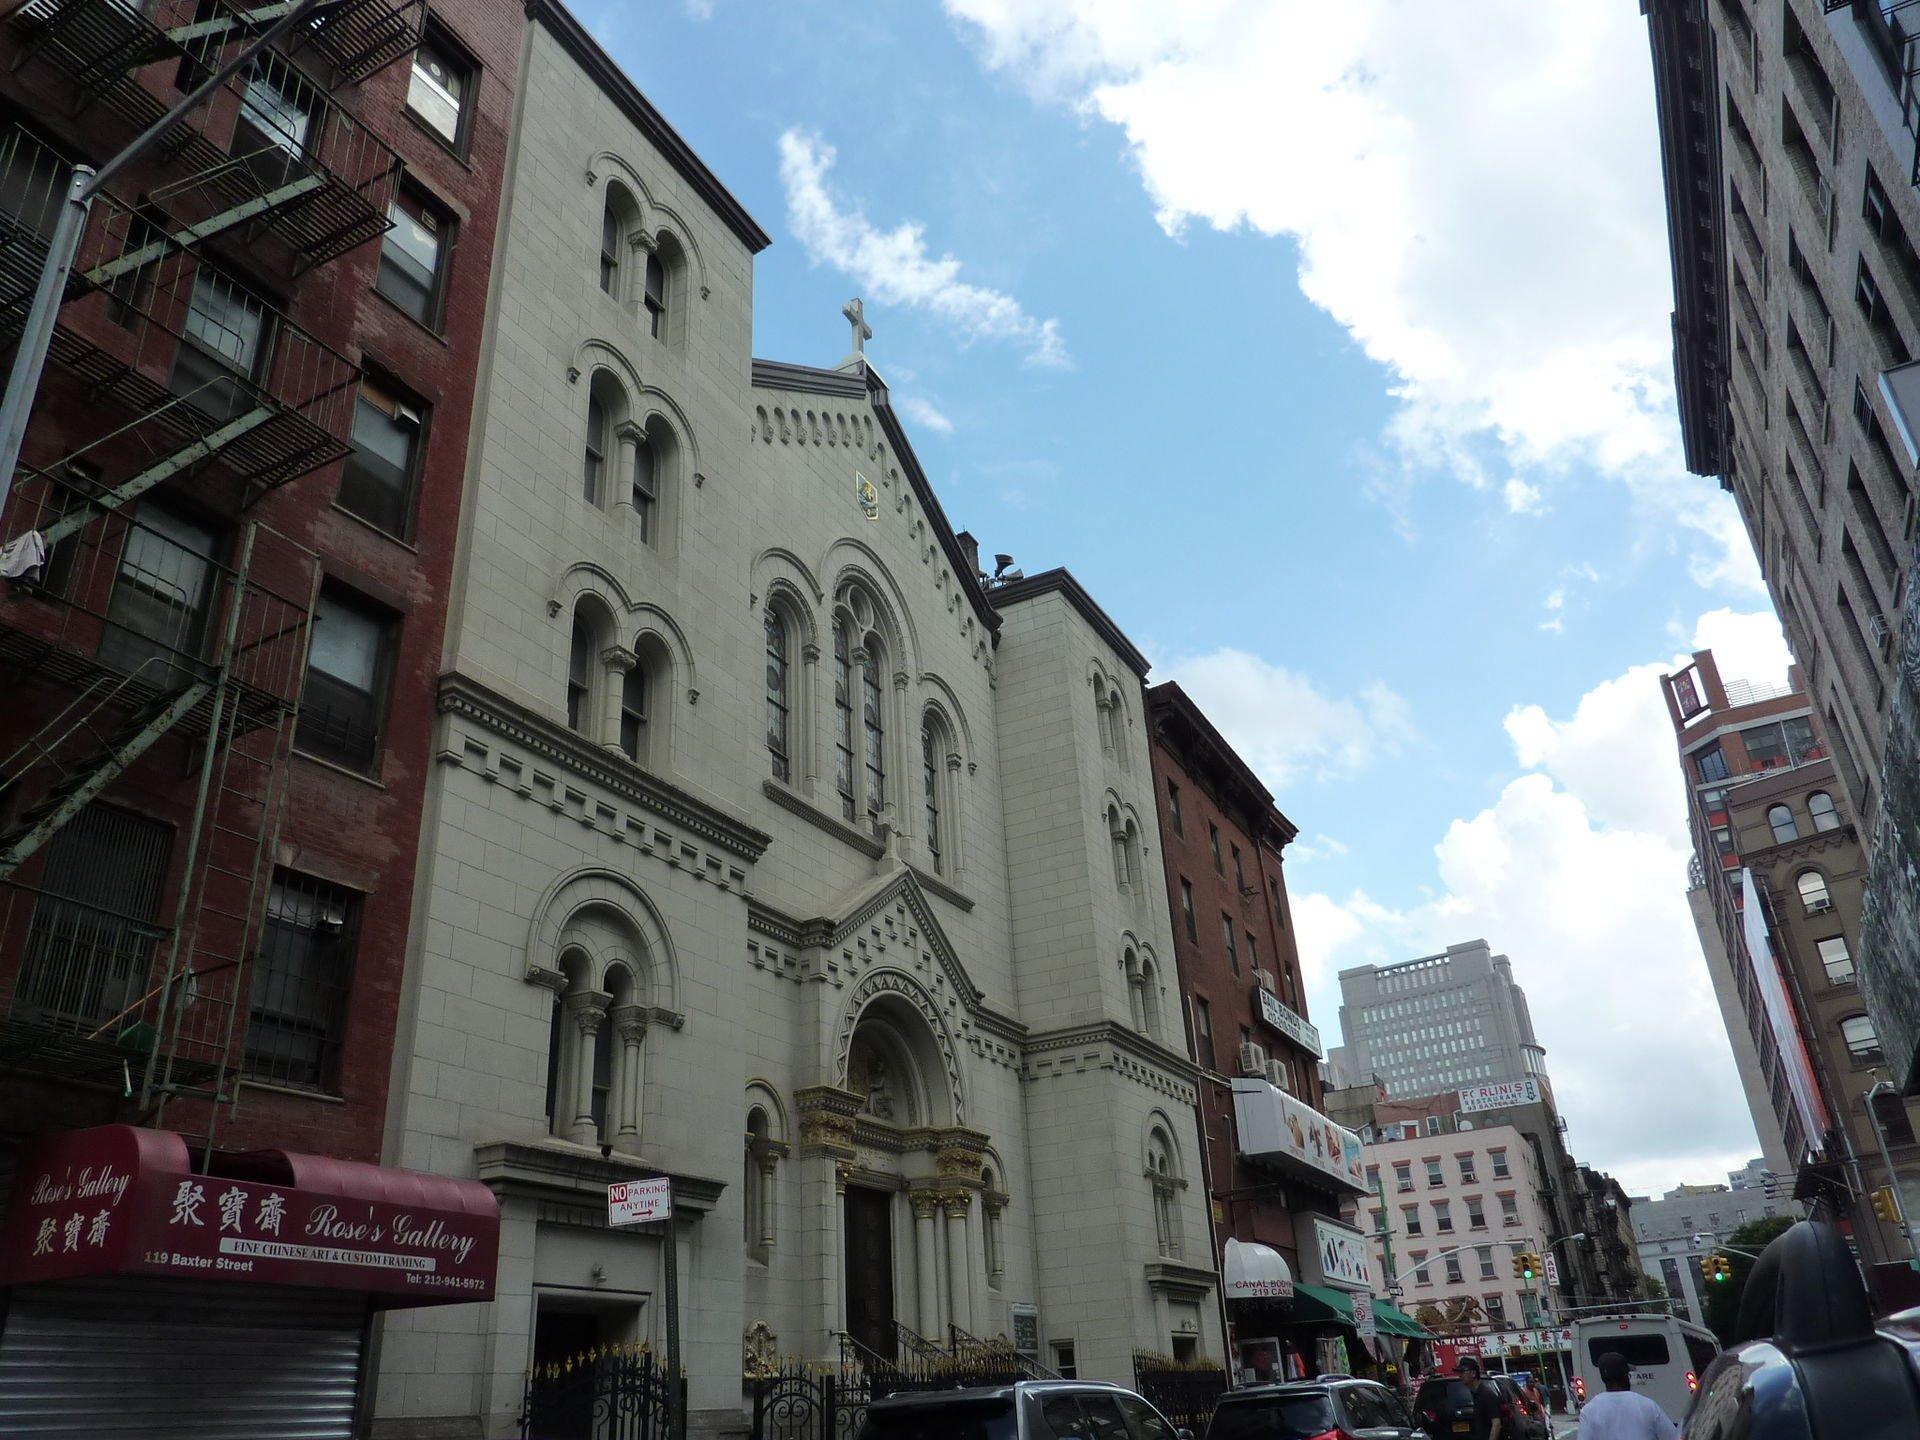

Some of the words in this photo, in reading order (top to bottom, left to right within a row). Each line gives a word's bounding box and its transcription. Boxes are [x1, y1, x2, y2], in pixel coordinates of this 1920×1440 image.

[1261, 991, 1279, 1013] BAIL
[1278, 1004, 1301, 1030] BONDS
[1464, 1092, 1522, 1105] RESTAURANT
[31, 1166, 72, 1205] Rose's
[77, 1165, 132, 1206] Gallery
[611, 1186, 627, 1201] NO
[628, 1184, 666, 1197] PARKING
[620, 1199, 660, 1211] ANYTIME
[304, 1204, 387, 1242] Rose's
[392, 1214, 478, 1264] Gallery
[144, 1251, 168, 1264] 119
[172, 1253, 213, 1268] Baxter
[216, 1259, 254, 1272] Street
[234, 1241, 260, 1253] FINE
[262, 1243, 308, 1257] CHINESE
[310, 1249, 330, 1260] ART
[332, 1251, 339, 1260] &
[341, 1251, 382, 1264] CUSTOM
[382, 1255, 426, 1268] FRAMING
[1545, 1253, 1557, 1280] PARK
[406, 1272, 422, 1284] Tel:
[424, 1275, 485, 1290] 212-941-5972
[1235, 1280, 1268, 1288] CANAL
